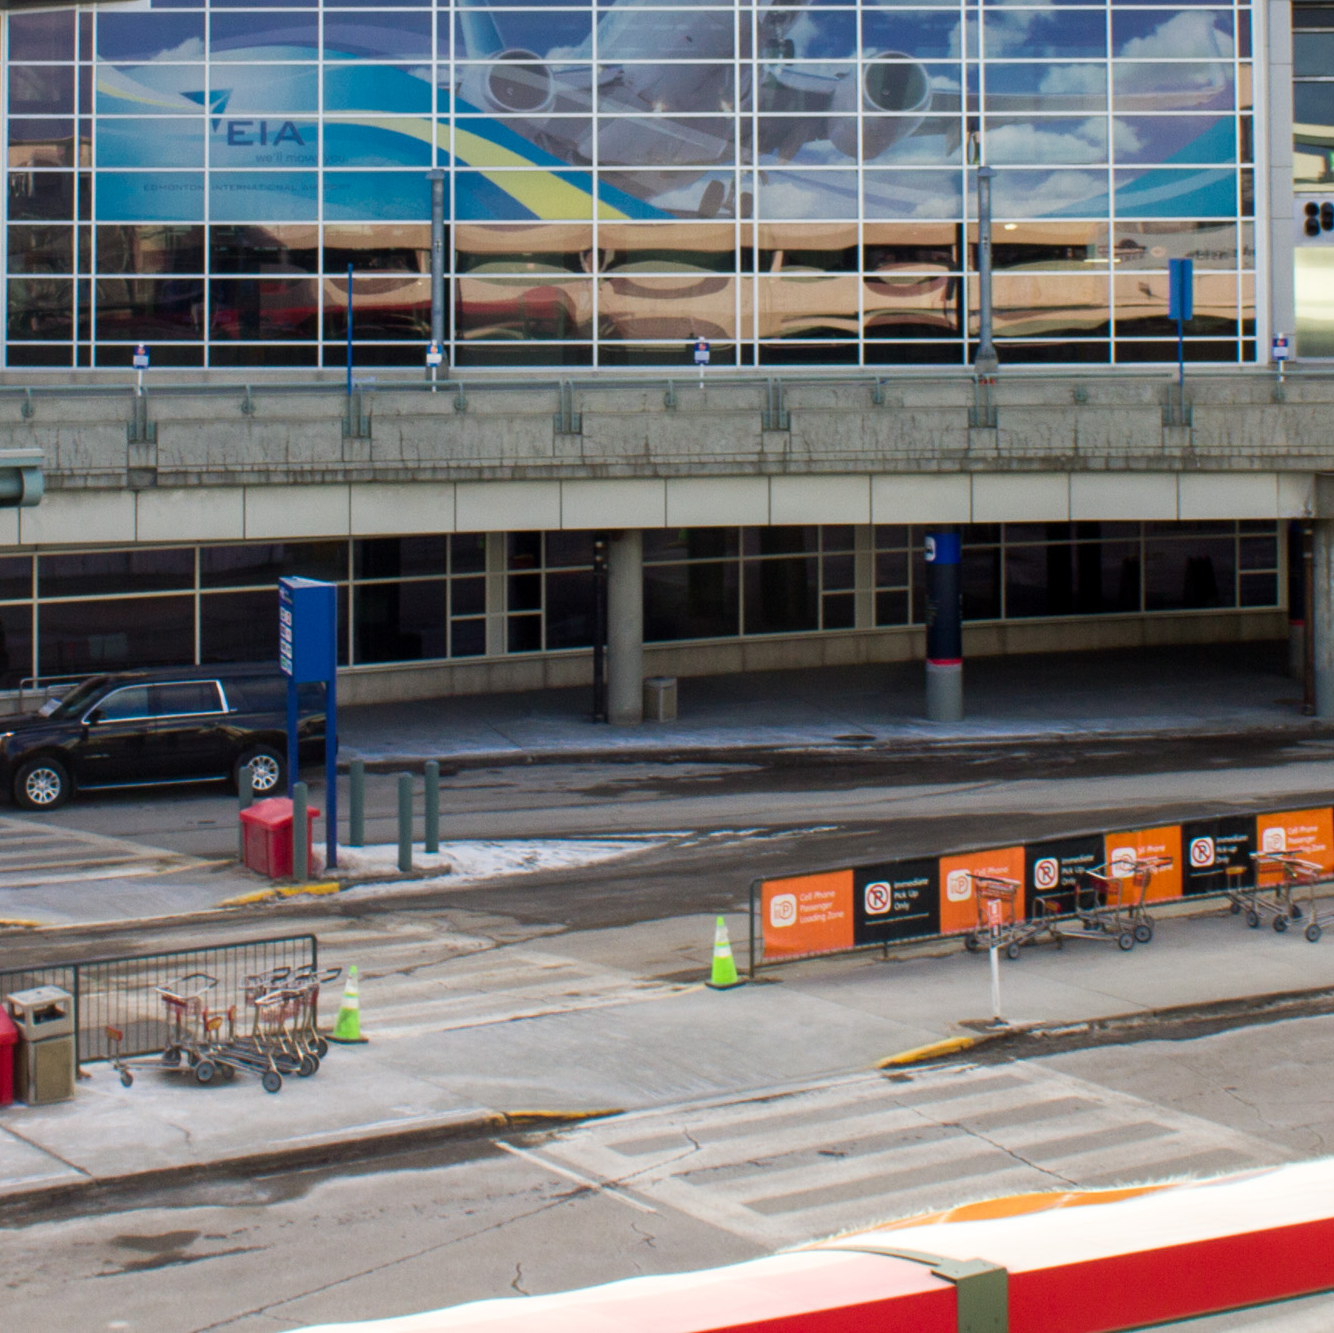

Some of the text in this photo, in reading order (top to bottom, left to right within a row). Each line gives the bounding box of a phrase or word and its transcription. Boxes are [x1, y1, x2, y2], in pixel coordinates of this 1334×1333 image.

[227, 121, 305, 146] EIA
[255, 151, 282, 163] we'll
[144, 183, 204, 192] EDMONTON
[209, 183, 296, 192] INTERNATIONAL
[894, 877, 929, 889] Immediate
[799, 890, 835, 902] Cell Phone
[894, 889, 919, 900] Pick Up
[799, 901, 834, 913] Passenger
[894, 901, 910, 912] Only
[799, 910, 844, 924] Loading Zone
